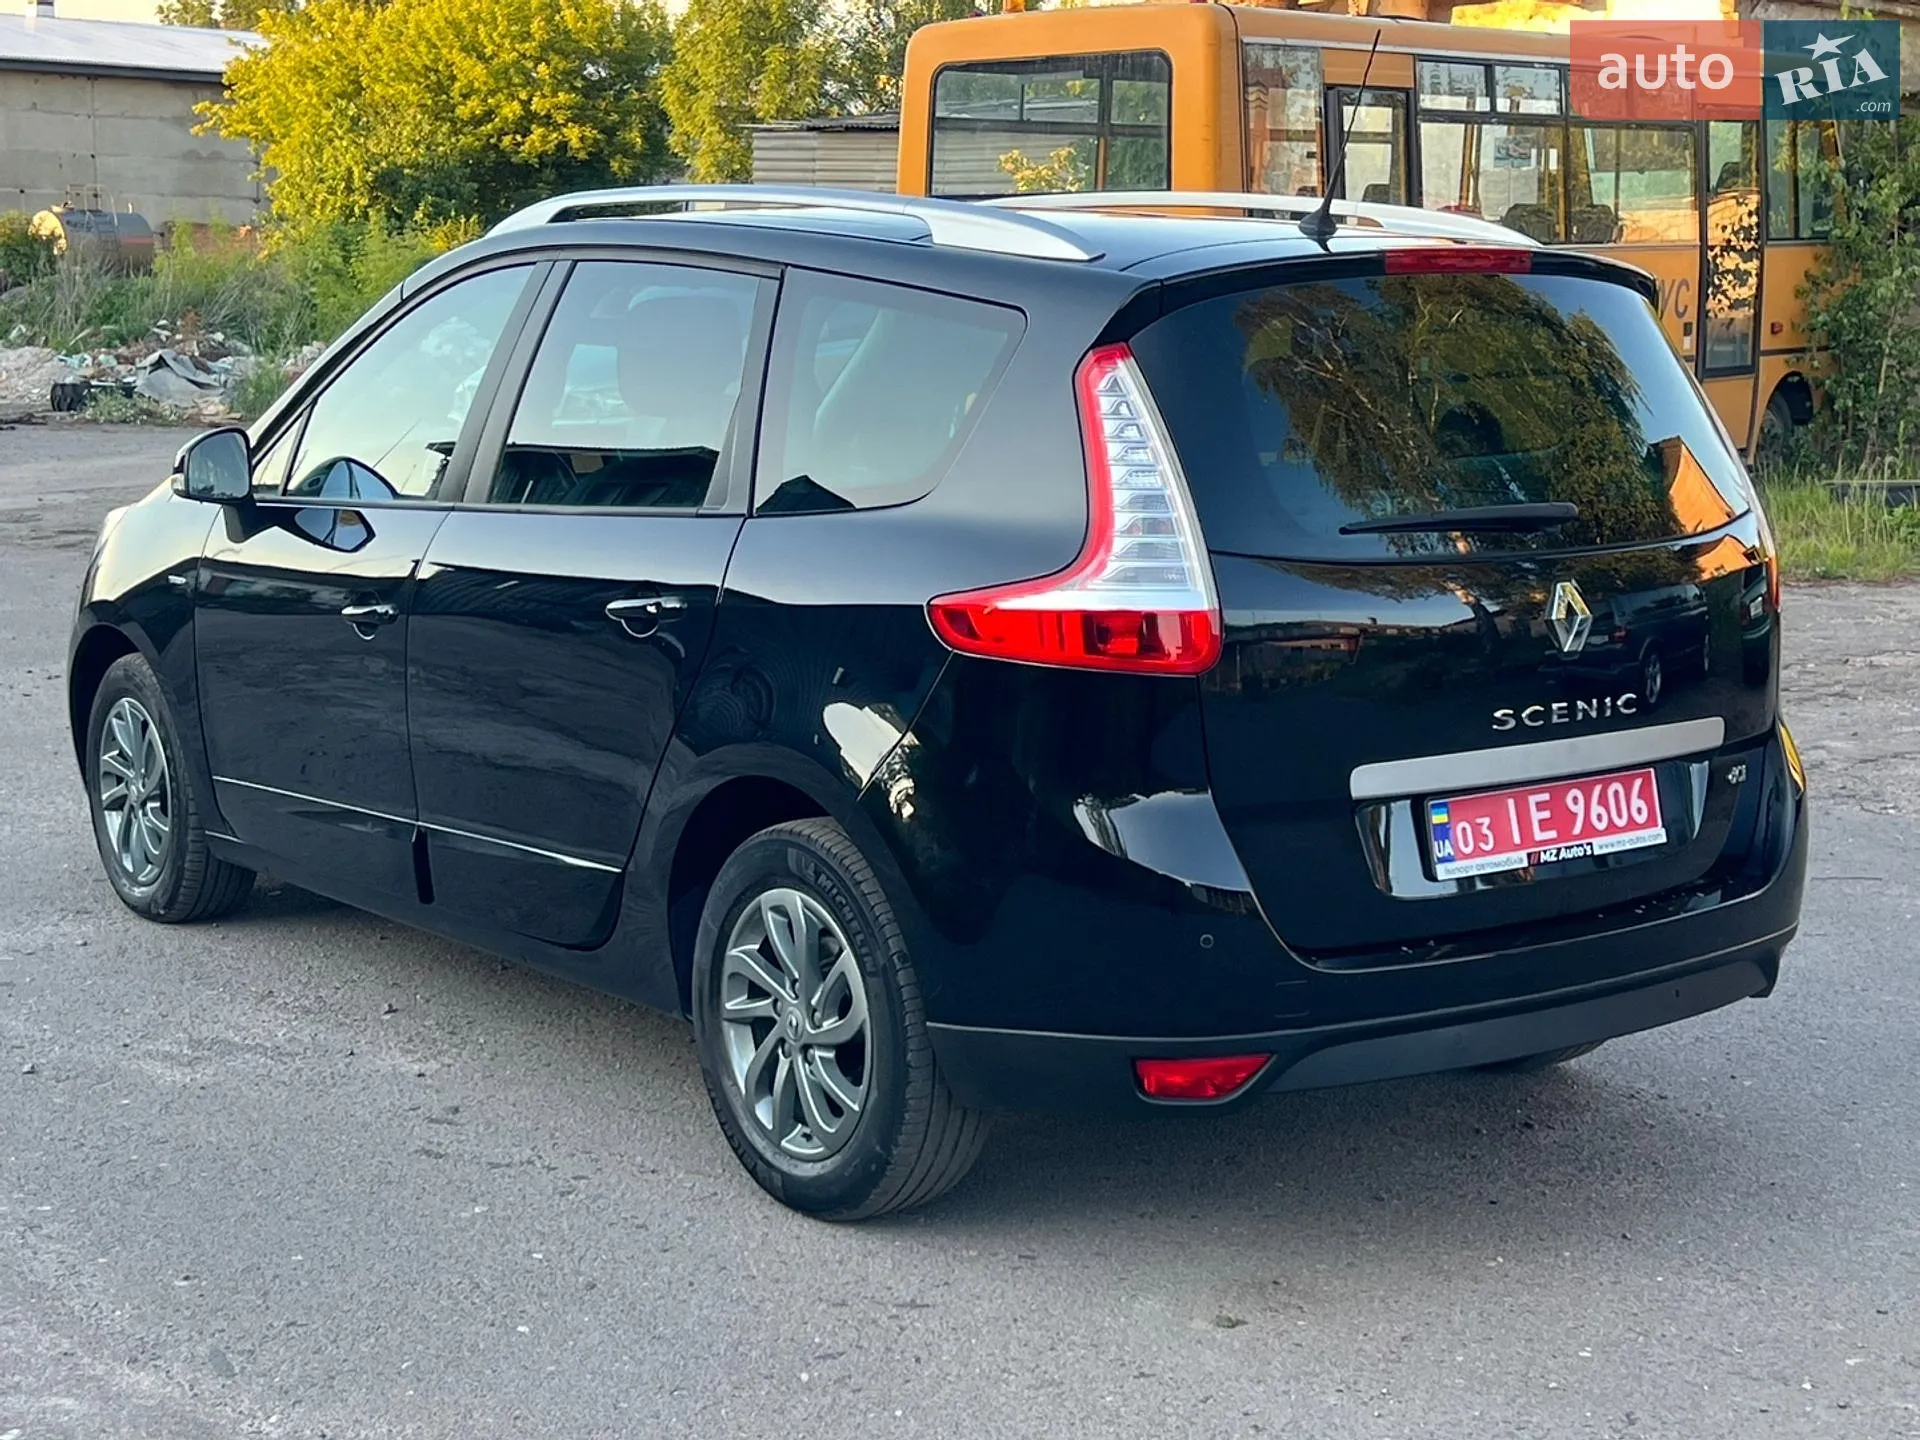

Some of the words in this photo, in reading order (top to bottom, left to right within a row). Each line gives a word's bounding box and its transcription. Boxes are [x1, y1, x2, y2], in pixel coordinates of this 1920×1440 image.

[1491, 692, 1638, 731] SCENIC
[1456, 817, 1495, 854] 03
[1506, 792, 1558, 845] IE
[1564, 777, 1649, 836] 9606
[1434, 840, 1454, 858] UA
[1540, 847, 1557, 863] MZ
[1558, 844, 1592, 860] Auto's
